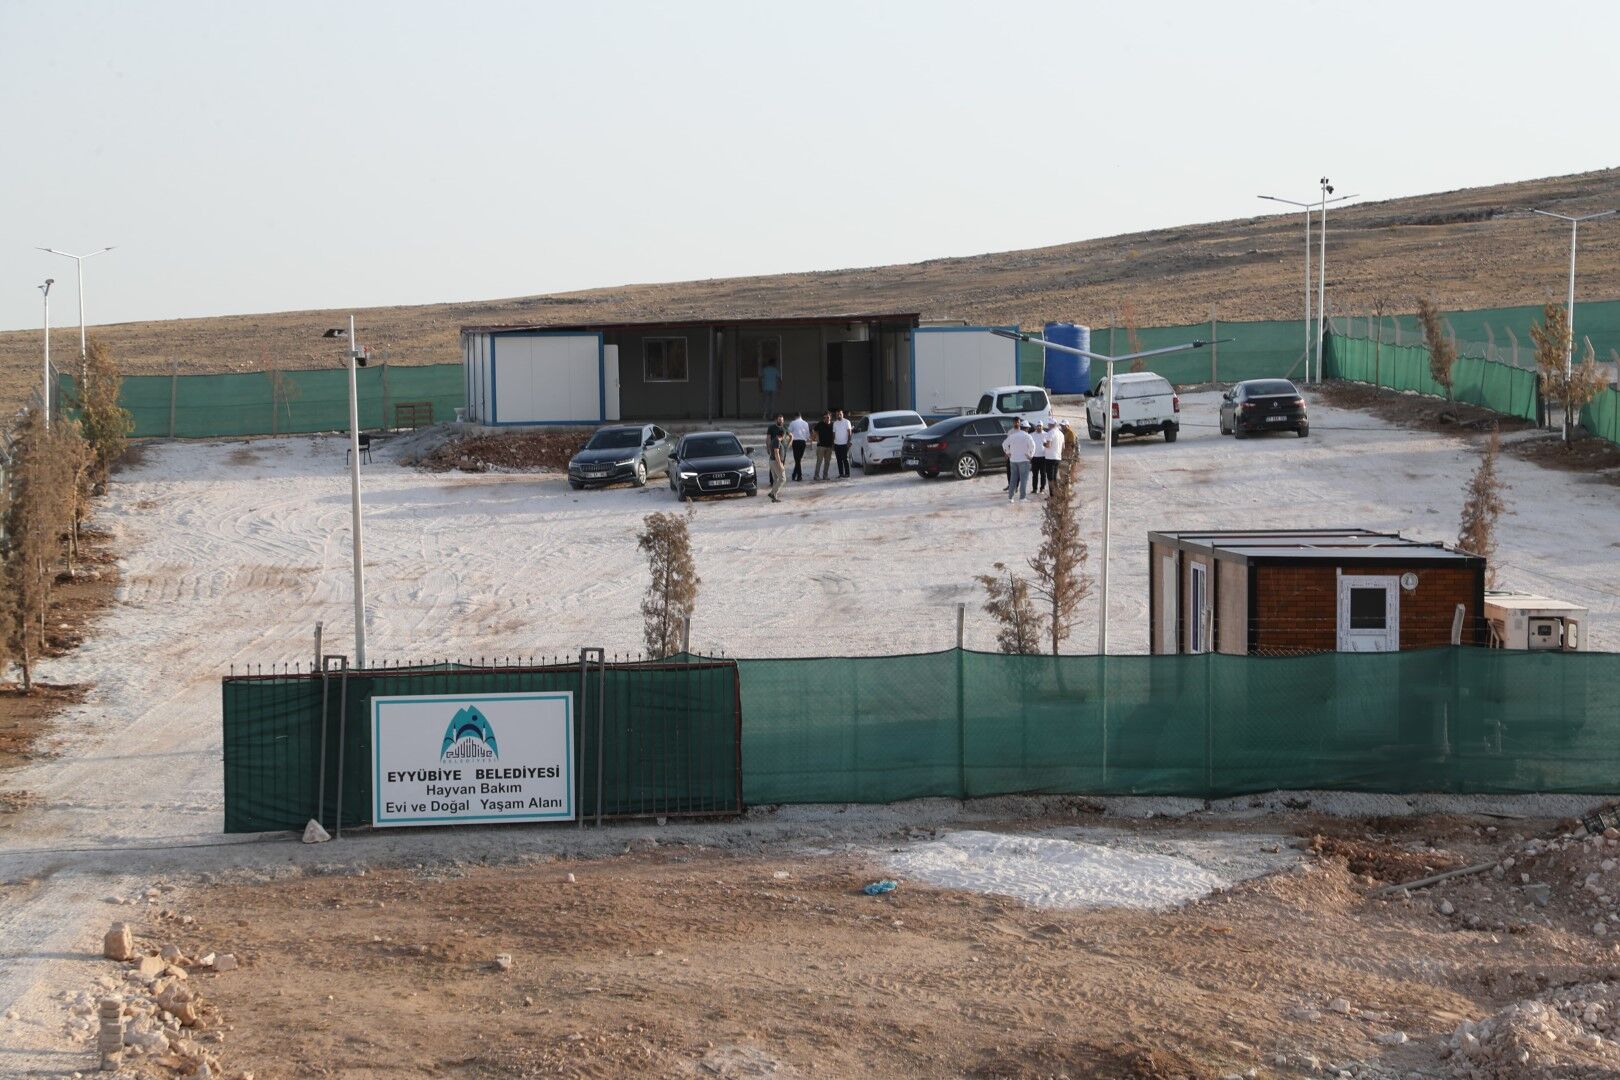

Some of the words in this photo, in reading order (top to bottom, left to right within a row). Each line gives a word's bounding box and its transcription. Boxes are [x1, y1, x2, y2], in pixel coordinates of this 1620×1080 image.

[387, 769, 462, 782] EYYÜBİYE
[475, 765, 560, 779] BELEDİYESİ
[426, 784, 476, 797] Hayvan
[480, 783, 522, 794] Bakım
[386, 801, 407, 813] Evi
[410, 803, 427, 812] ve
[431, 800, 470, 814] Doğal
[480, 799, 524, 811] Yaşam
[528, 797, 562, 808] Alanı
